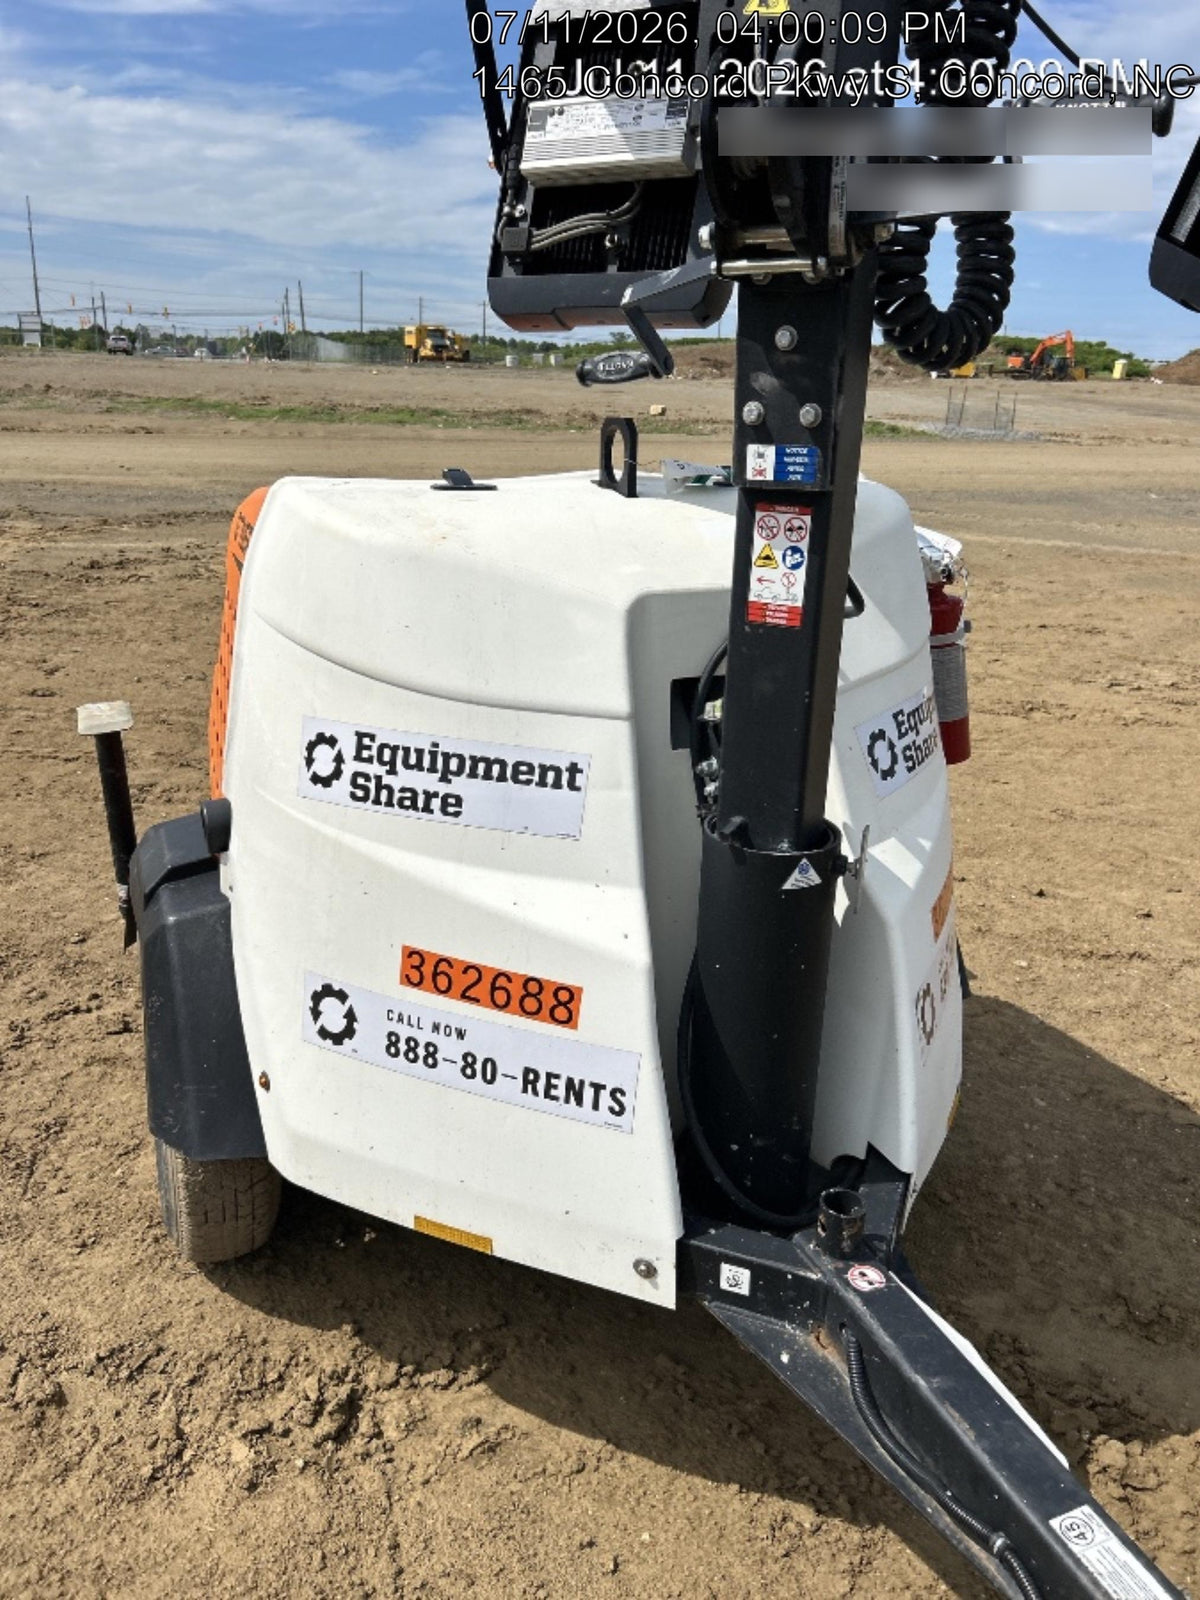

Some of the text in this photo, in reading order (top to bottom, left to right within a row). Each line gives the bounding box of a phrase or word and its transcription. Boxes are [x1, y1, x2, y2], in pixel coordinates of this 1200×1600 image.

[353, 730, 584, 792] Equipment
[349, 771, 464, 818] Share
[405, 950, 576, 1025] 362688
[387, 1009, 467, 1041] CALL NOW
[385, 1031, 627, 1117] 888-80-RENTS
